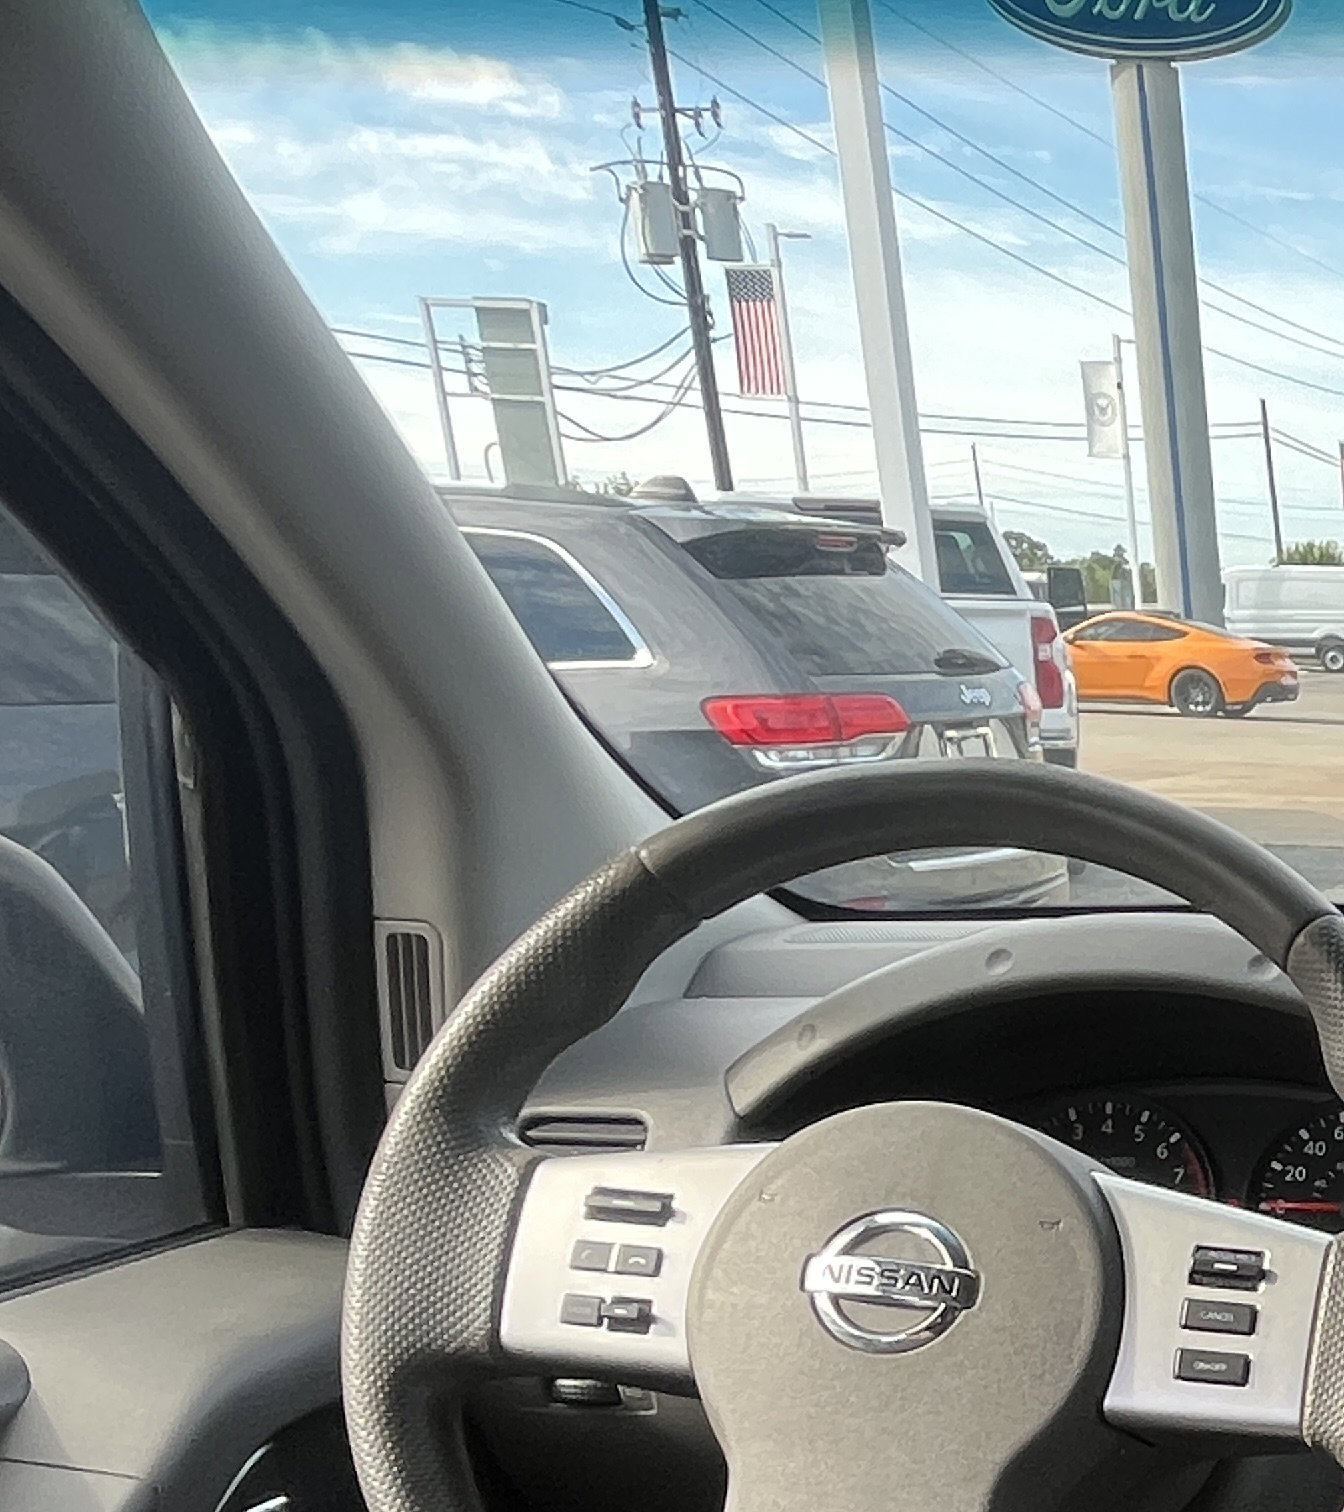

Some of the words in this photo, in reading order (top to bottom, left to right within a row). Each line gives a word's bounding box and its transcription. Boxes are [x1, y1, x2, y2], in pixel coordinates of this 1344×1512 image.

[1072, 1123, 1084, 1141] 3
[1100, 1118, 1114, 1135] 4
[1133, 1125, 1146, 1142] 5
[1156, 1142, 1169, 1160] 6
[1303, 1141, 1327, 1156] 40
[1173, 1167, 1186, 1185] 7
[1284, 1165, 1307, 1182] 20
[821, 1262, 961, 1299] NISSAN
